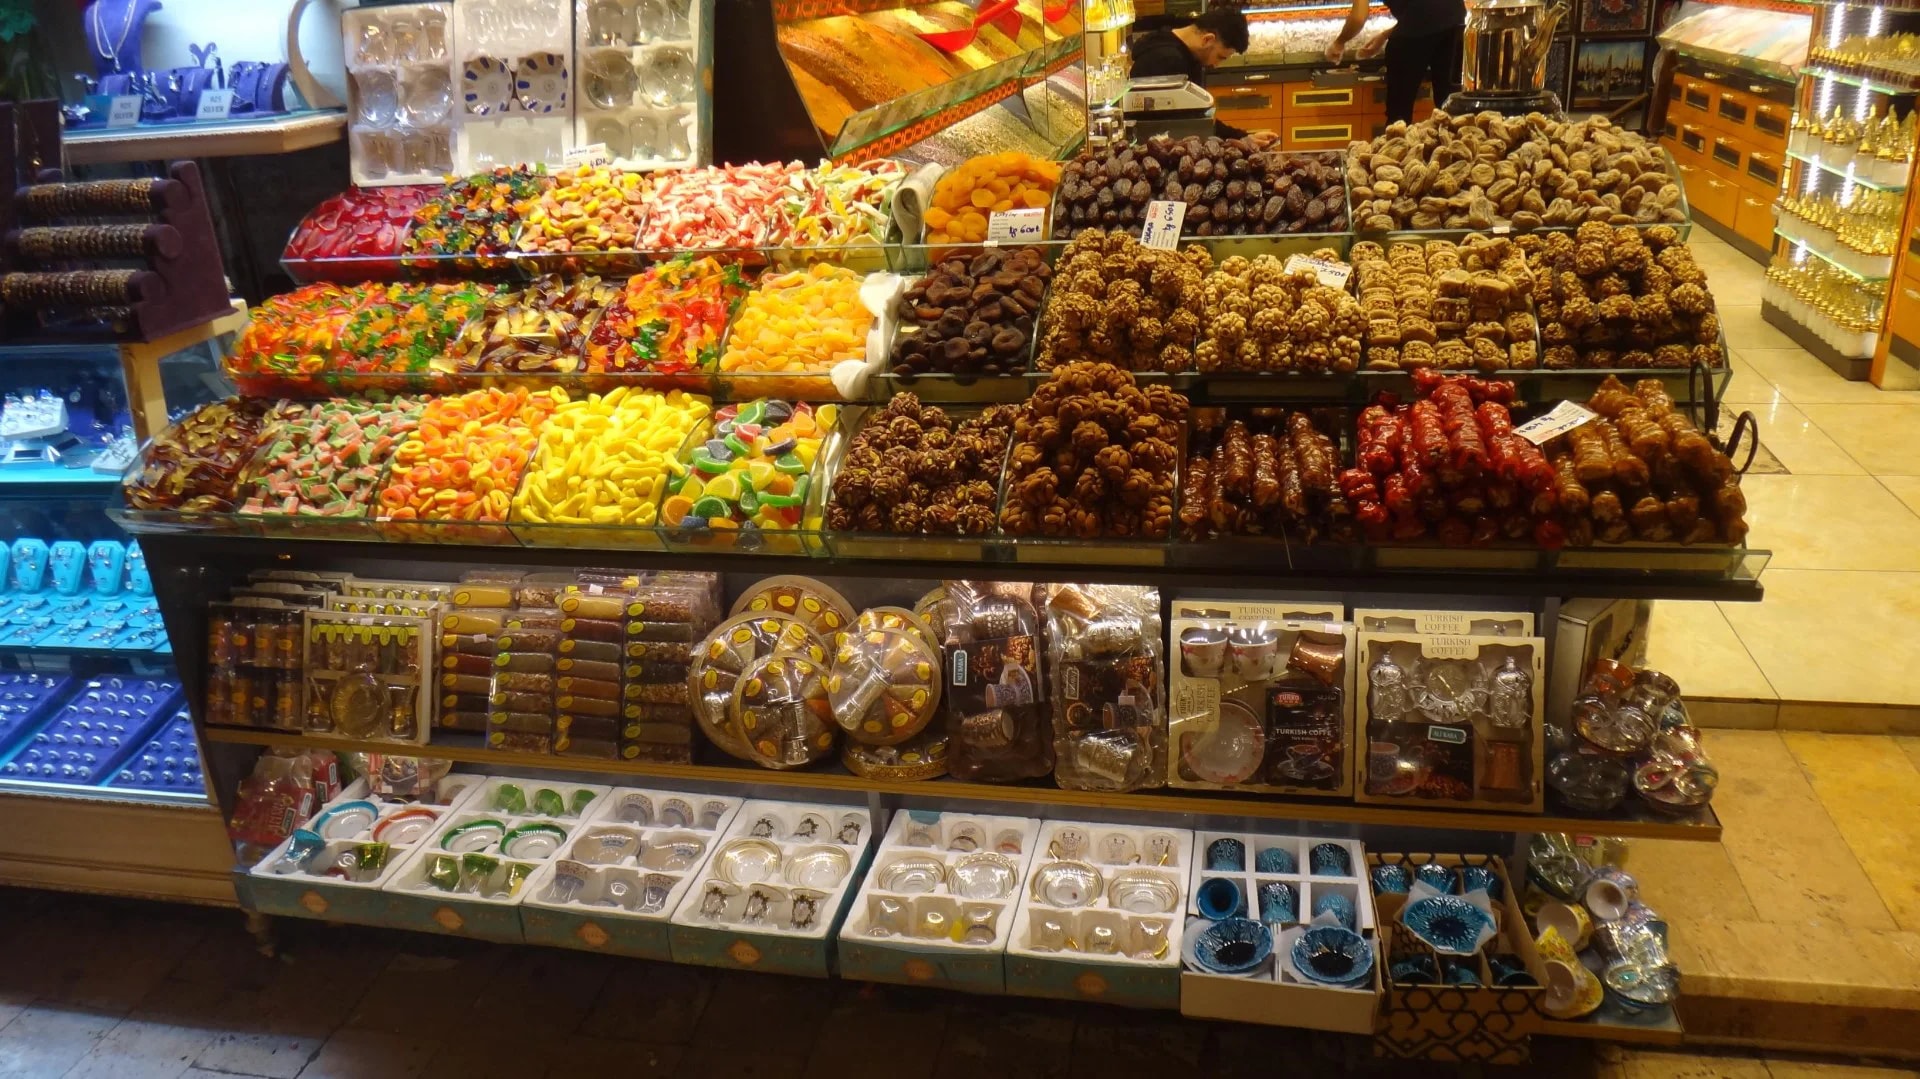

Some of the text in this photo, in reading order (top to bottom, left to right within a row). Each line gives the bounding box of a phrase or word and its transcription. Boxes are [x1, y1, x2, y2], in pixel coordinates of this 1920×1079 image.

[1237, 606, 1276, 615] TURKISH
[1424, 614, 1463, 623] TURKISH
[1424, 623, 1460, 632] COFFEE
[1430, 637, 1471, 646] TURKISH
[1431, 647, 1467, 656] COFFEE
[1275, 728, 1307, 736] TURKISH
